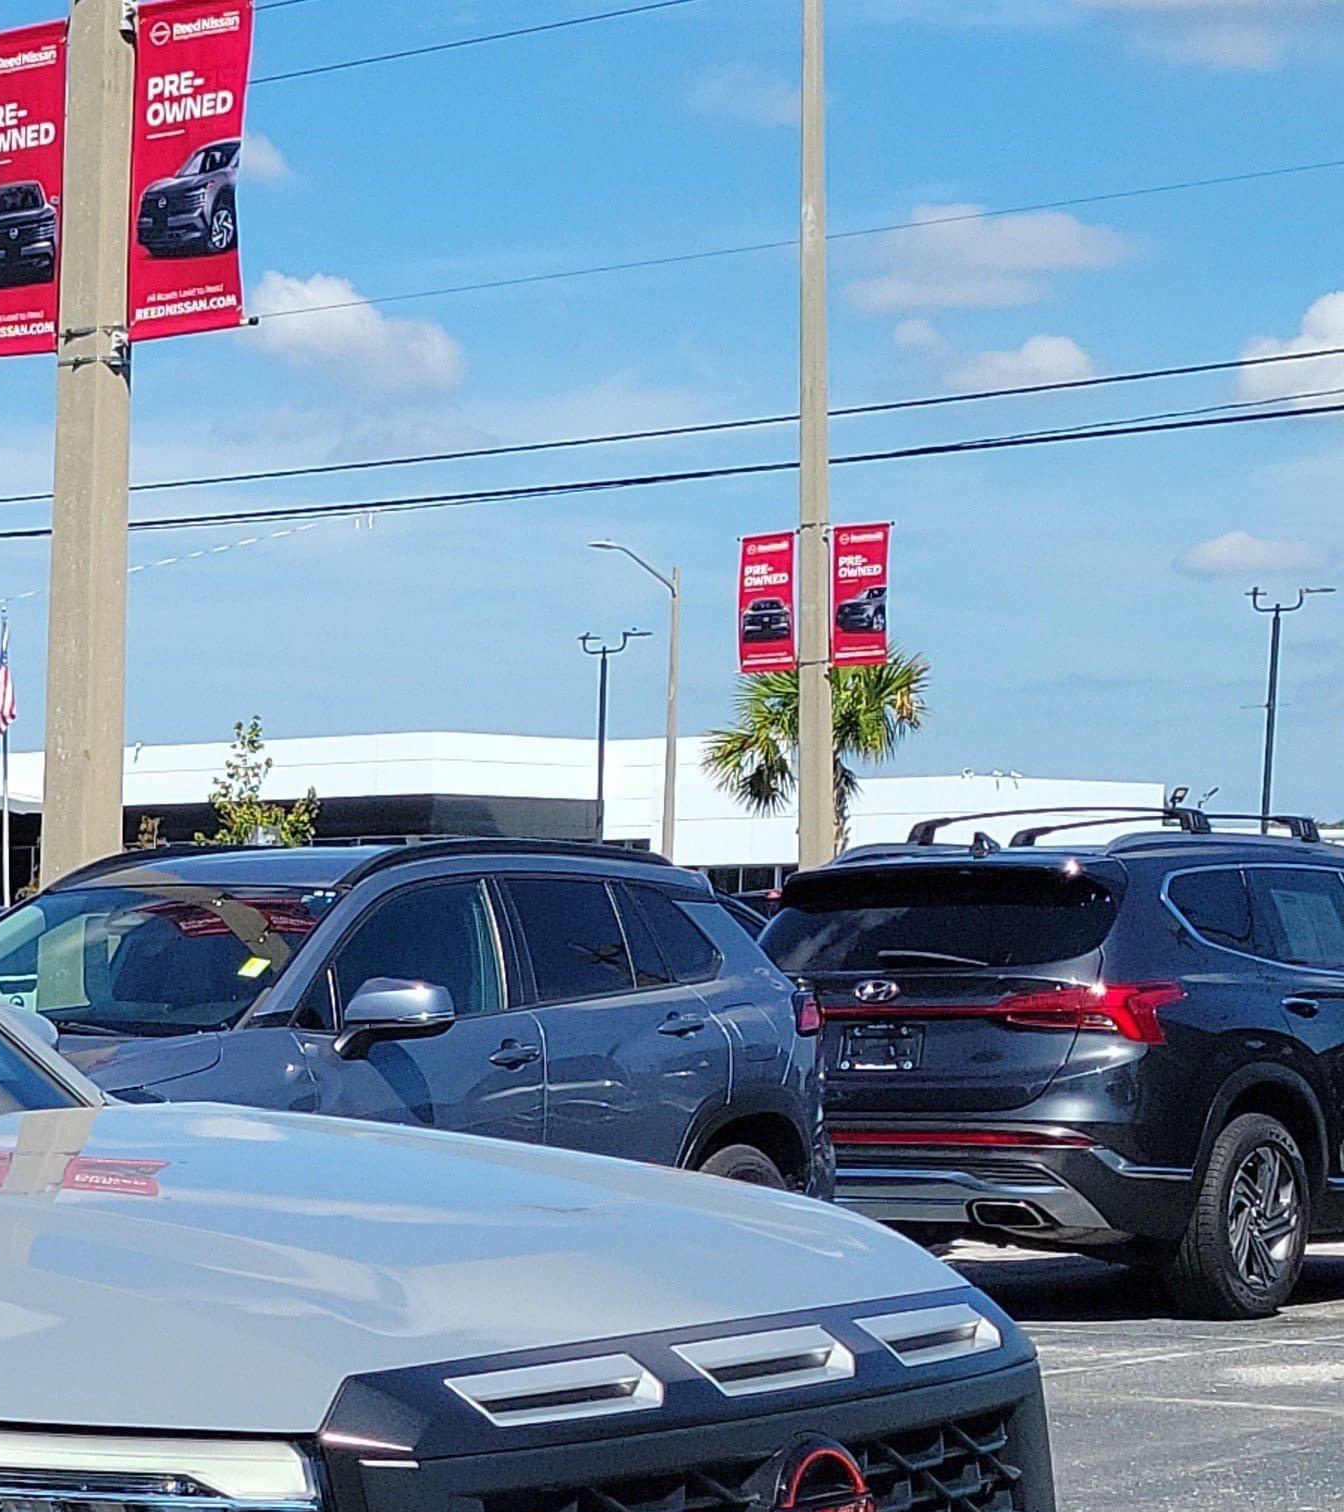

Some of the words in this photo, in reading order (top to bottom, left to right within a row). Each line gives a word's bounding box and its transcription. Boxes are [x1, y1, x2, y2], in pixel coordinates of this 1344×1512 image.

[147, 70, 205, 101] PRE-
[146, 90, 234, 127] OWNED
[744, 572, 790, 588] OWNED
[838, 564, 883, 579] OWNED
